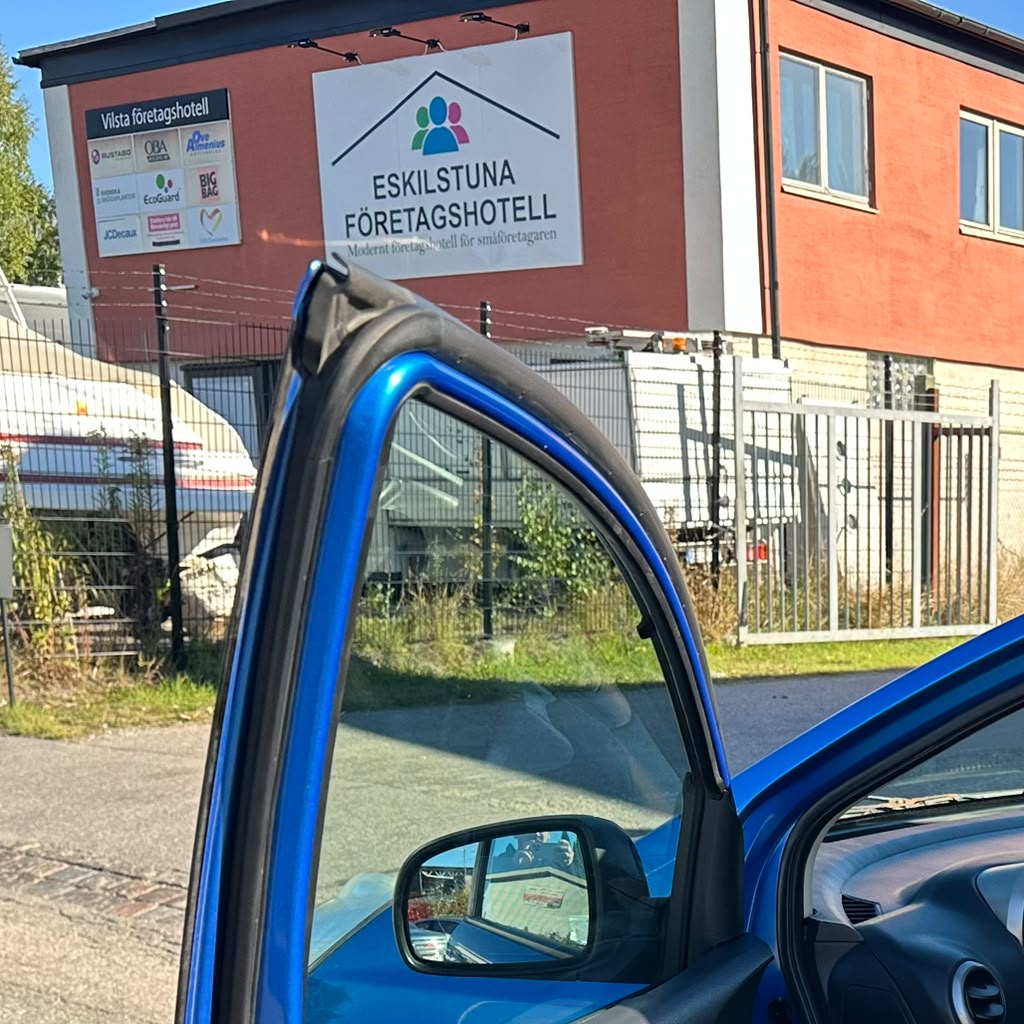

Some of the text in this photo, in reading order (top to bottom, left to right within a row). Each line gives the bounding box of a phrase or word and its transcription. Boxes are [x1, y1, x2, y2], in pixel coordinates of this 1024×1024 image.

[101, 97, 209, 130] Vilsta företagshotell
[200, 172, 217, 187] BIG
[373, 159, 516, 200] ESKILSTUNA
[144, 193, 180, 205] EcoGuard
[201, 186, 218, 199] BAG
[345, 193, 557, 238] FÖRETAGSHOTELL
[104, 230, 137, 241] JCDecaux
[347, 228, 557, 257] Modernt företagshotell för småföretagaren
